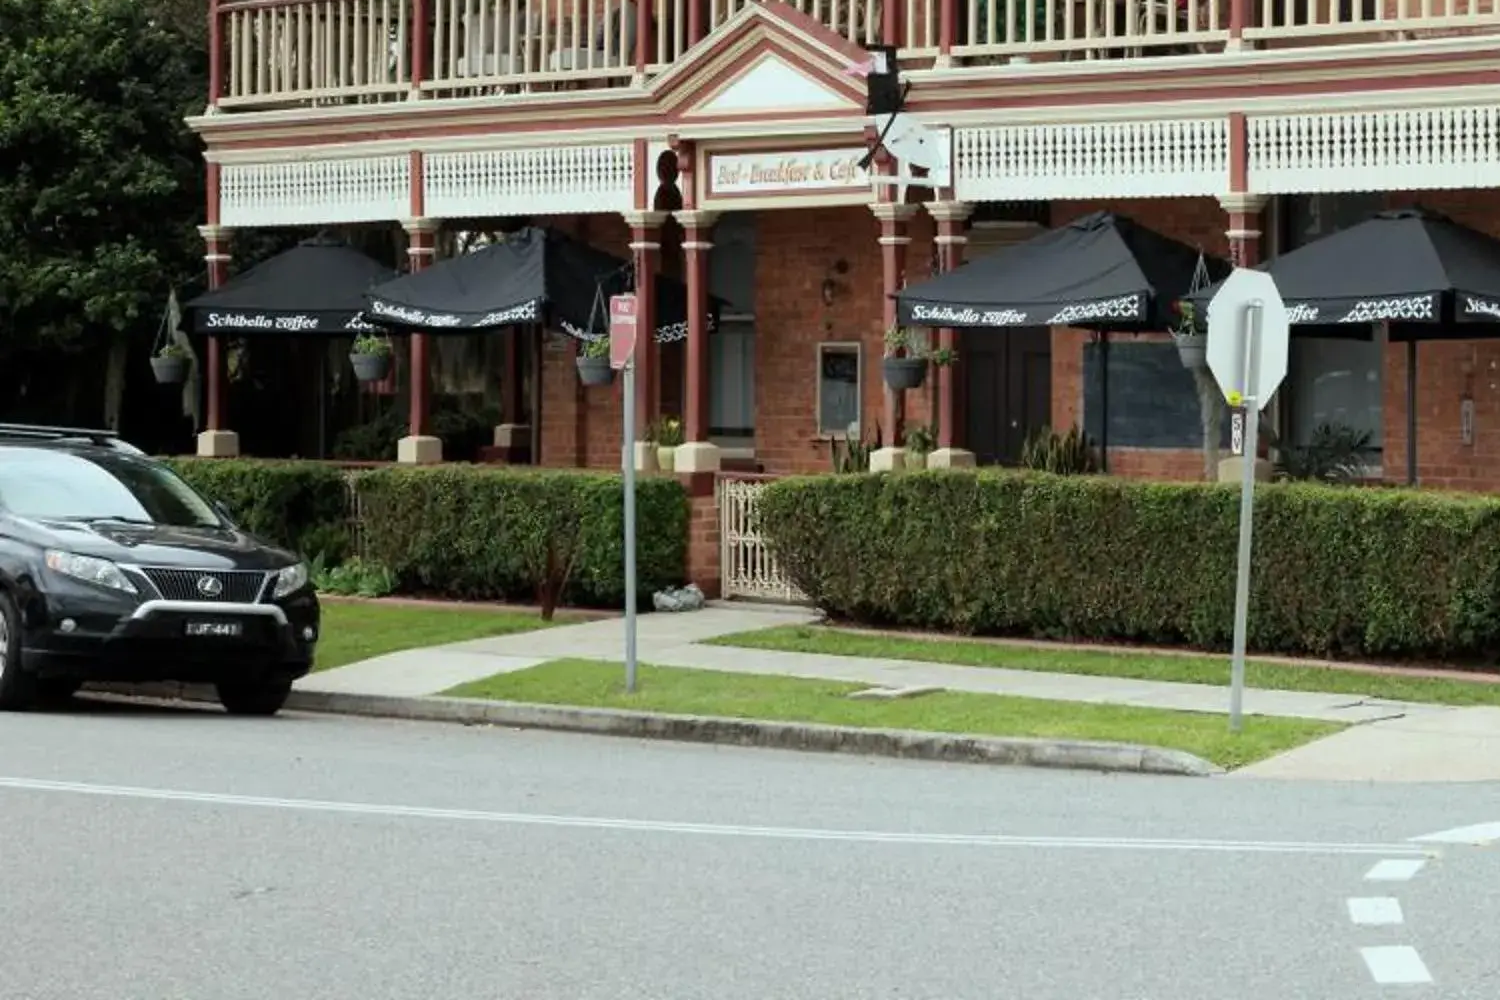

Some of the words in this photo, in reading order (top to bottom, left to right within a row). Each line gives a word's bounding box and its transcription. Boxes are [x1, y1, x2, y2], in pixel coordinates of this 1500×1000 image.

[207, 312, 273, 329] Schibello
[274, 314, 319, 331] coffee
[911, 304, 980, 324] Schibello
[981, 307, 1028, 326] coffee
